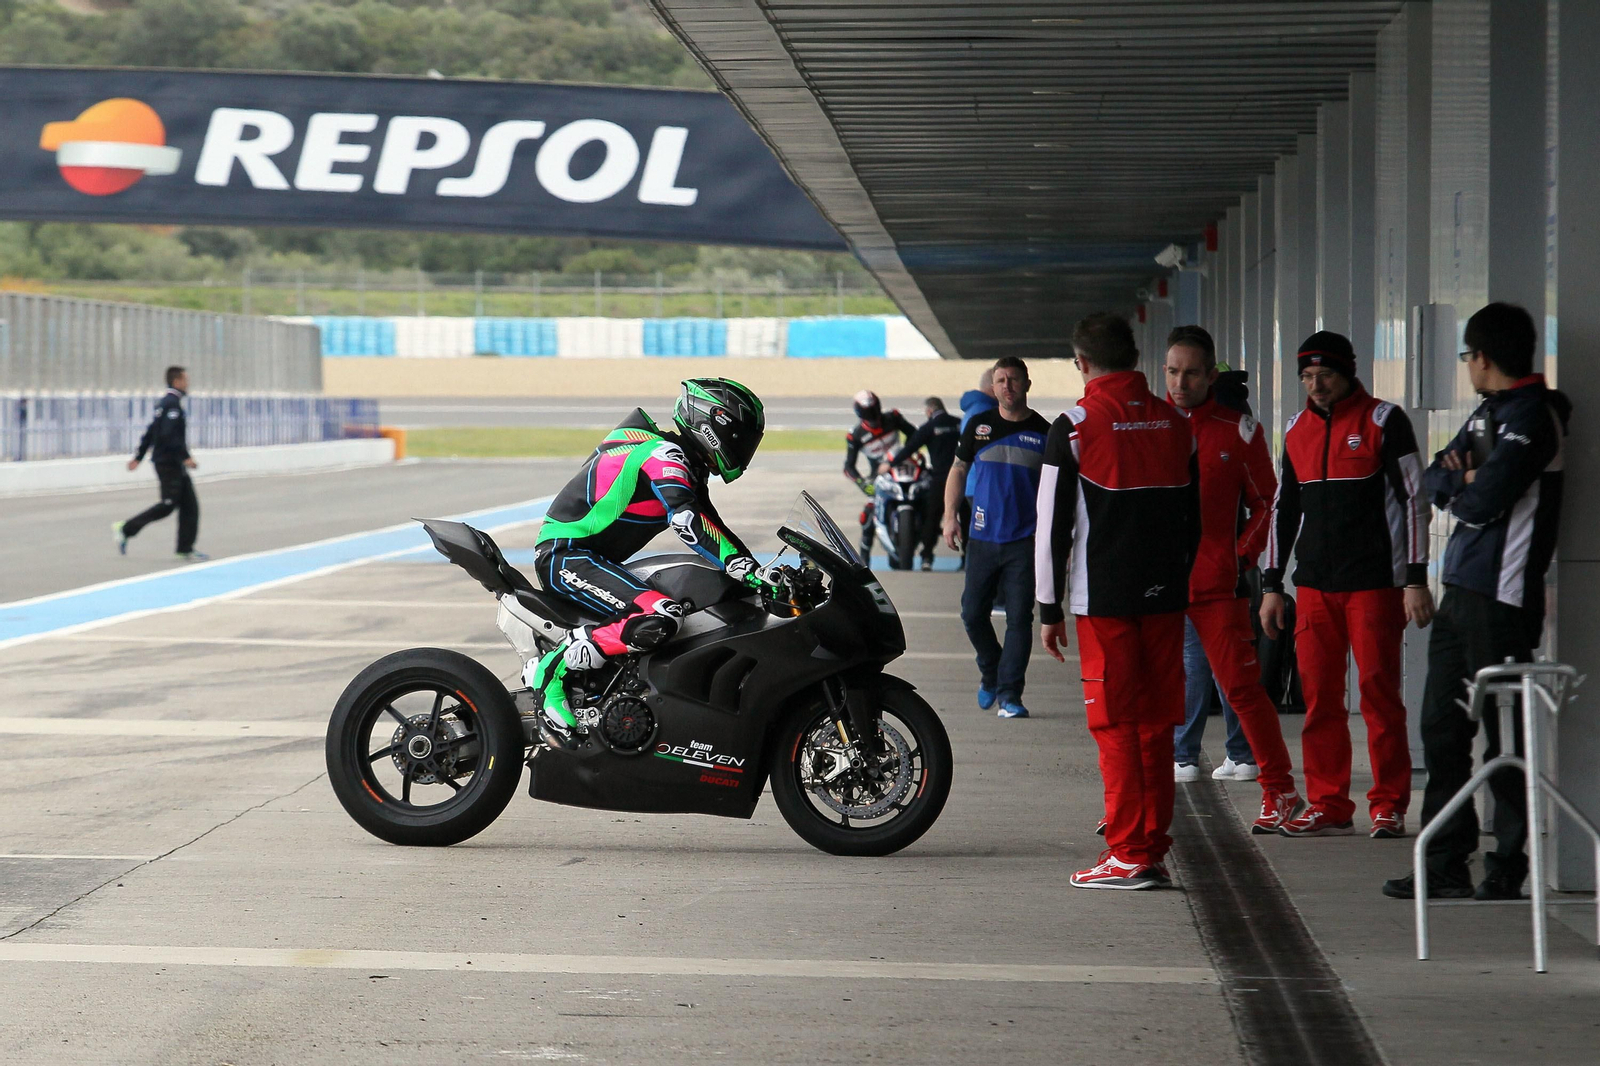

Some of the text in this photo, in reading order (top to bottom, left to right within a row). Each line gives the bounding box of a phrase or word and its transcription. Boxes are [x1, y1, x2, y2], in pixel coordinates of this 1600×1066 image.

[195, 107, 698, 206] REPSOL
[702, 427, 719, 447] SHOEI
[558, 568, 627, 610] alpinestars
[690, 740, 713, 752] team
[700, 775, 739, 788] DUCATI
